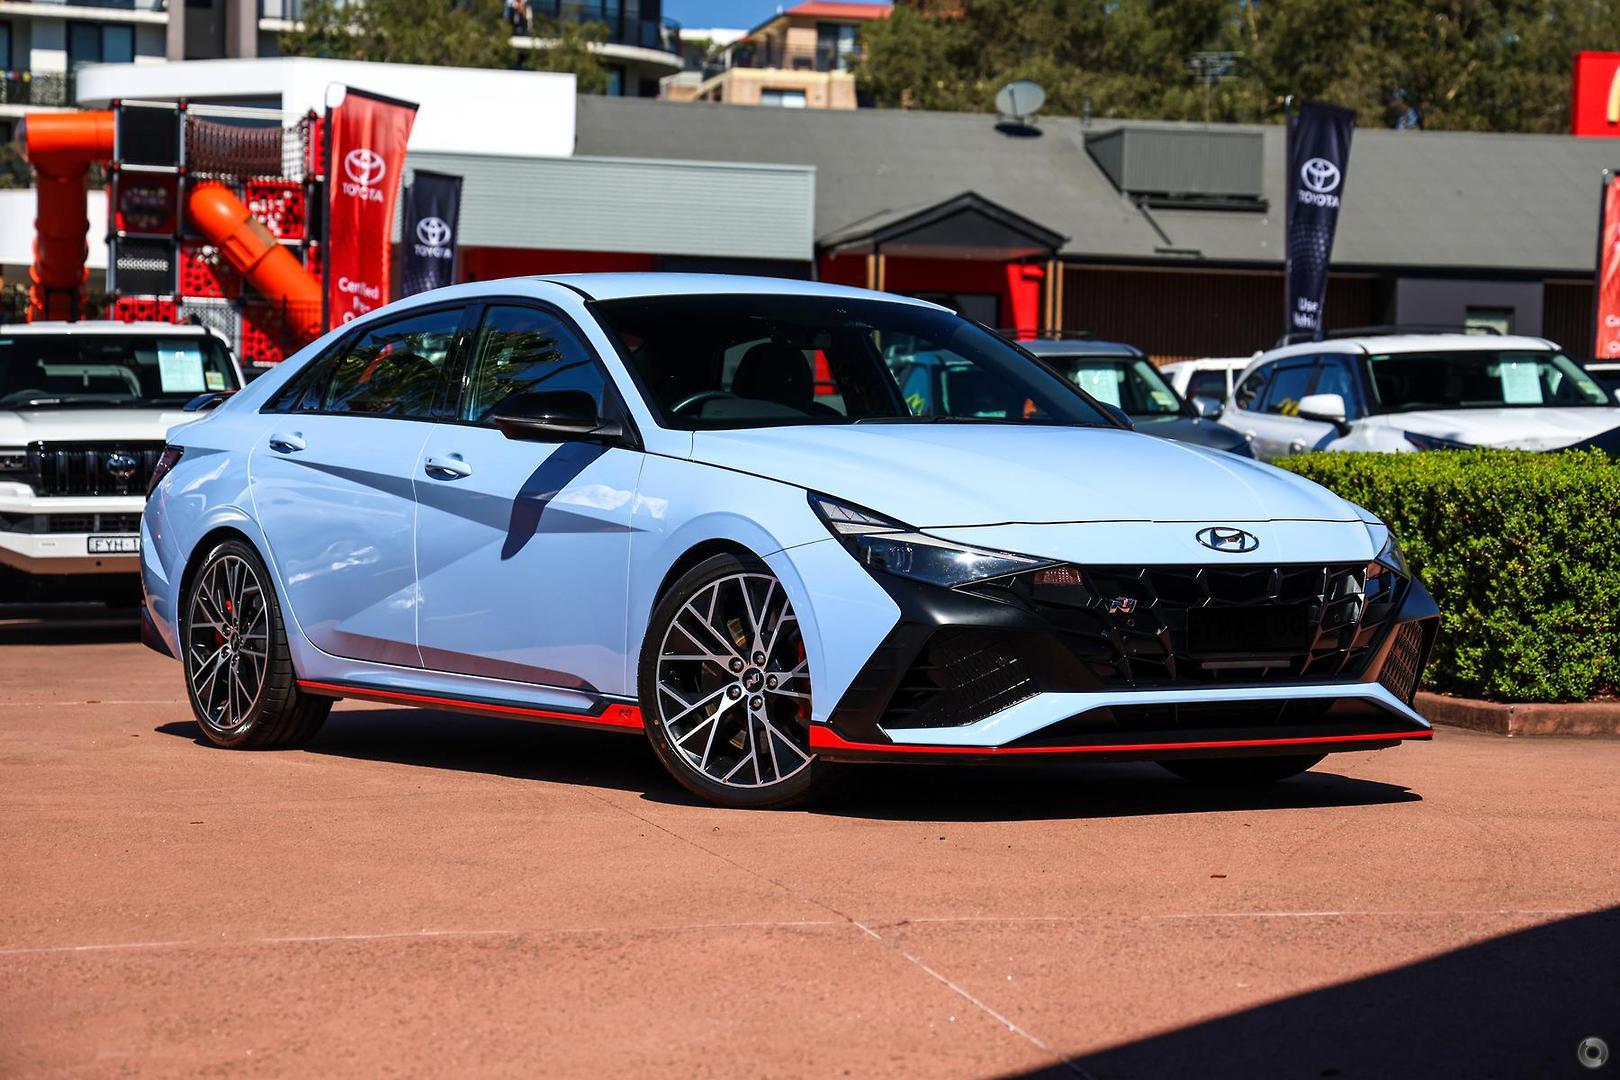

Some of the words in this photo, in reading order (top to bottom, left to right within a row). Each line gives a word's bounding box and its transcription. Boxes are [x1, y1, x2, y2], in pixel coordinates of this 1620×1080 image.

[342, 182, 384, 203] TOYOTA
[1298, 189, 1340, 208] TOYOTA
[414, 244, 453, 259] TOYOTA
